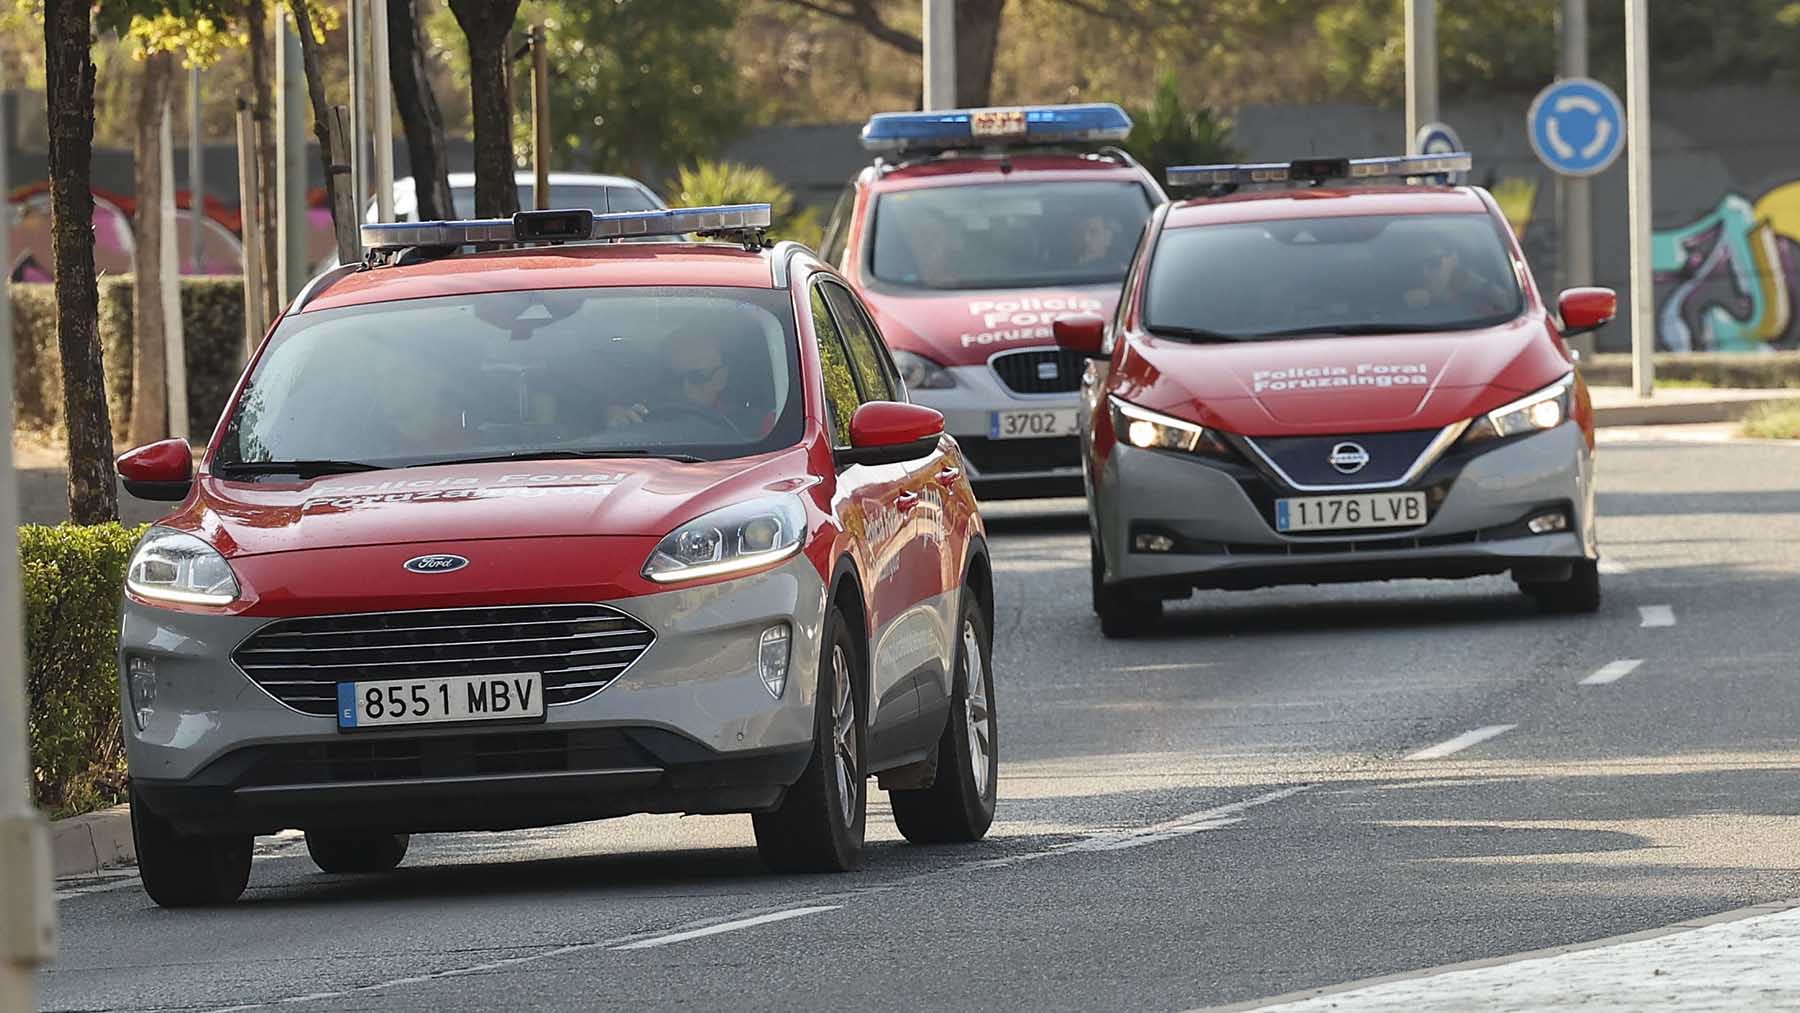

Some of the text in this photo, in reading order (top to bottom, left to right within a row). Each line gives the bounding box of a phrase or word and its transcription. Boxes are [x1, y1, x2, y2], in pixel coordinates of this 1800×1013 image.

[983, 311, 1057, 329] For
[1356, 363, 1427, 374] Foral
[1254, 374, 1428, 393] Foruzaingoa
[1005, 413, 1056, 434] 3702
[500, 472, 625, 483] Foral
[1298, 497, 1419, 525] 1176 LVB
[418, 557, 454, 568] Ford
[365, 679, 532, 719] 8551 MBV
[344, 709, 351, 718] E
